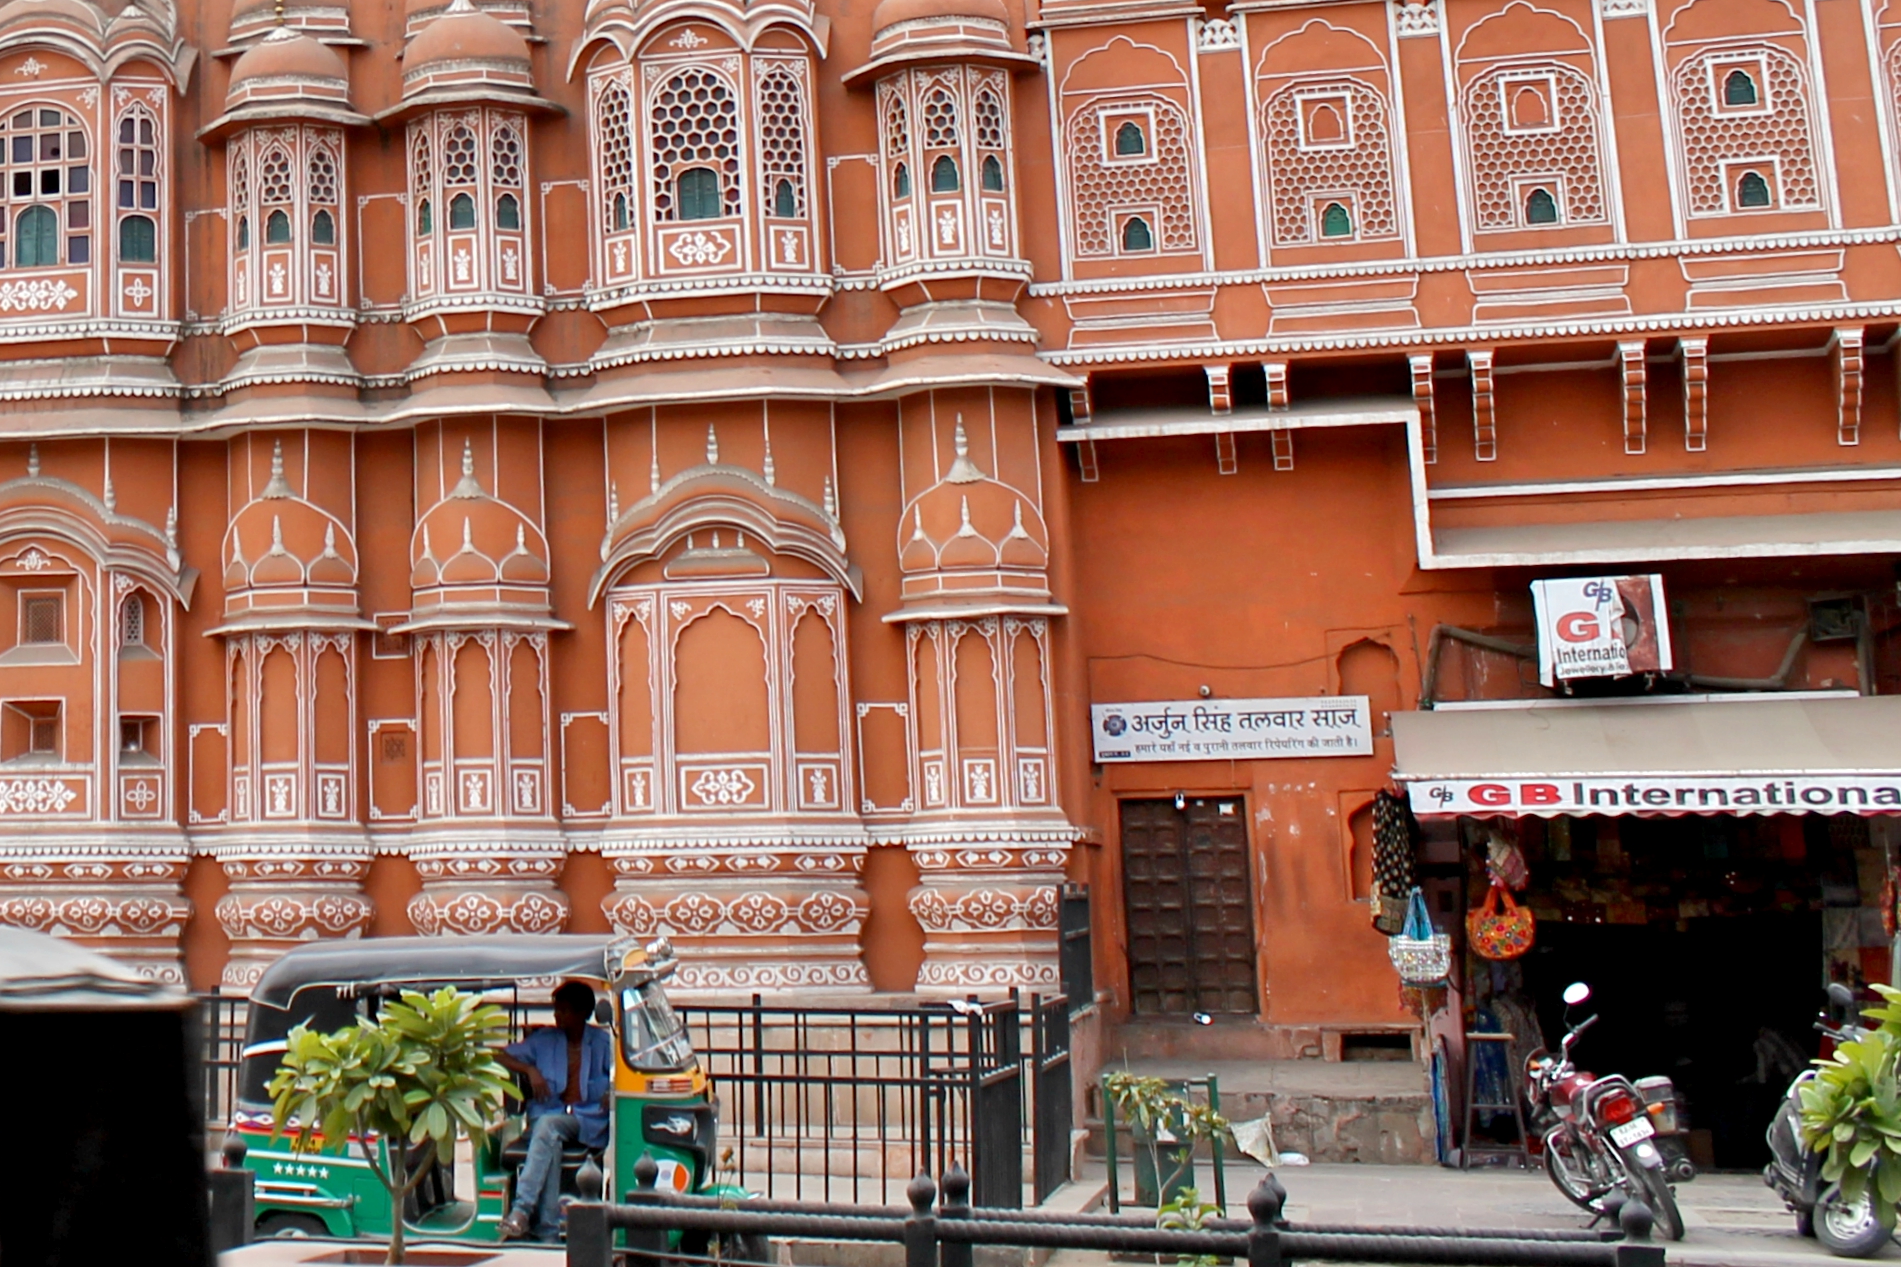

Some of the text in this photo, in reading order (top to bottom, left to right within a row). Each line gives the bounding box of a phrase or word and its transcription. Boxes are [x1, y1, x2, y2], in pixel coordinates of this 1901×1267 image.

[1557, 642, 1626, 664] Internatio
[1131, 707, 1191, 739] अर्जुन
[1193, 706, 1231, 733] सिंह
[1237, 710, 1305, 731] तलवार
[1135, 741, 1157, 753] हमारे
[1203, 740, 1229, 754] पुरानी
[1231, 740, 1263, 750] तलवार
[1306, 736, 1319, 748] की
[1321, 736, 1344, 747] जाती
[1468, 782, 1901, 806] GB Internationa
